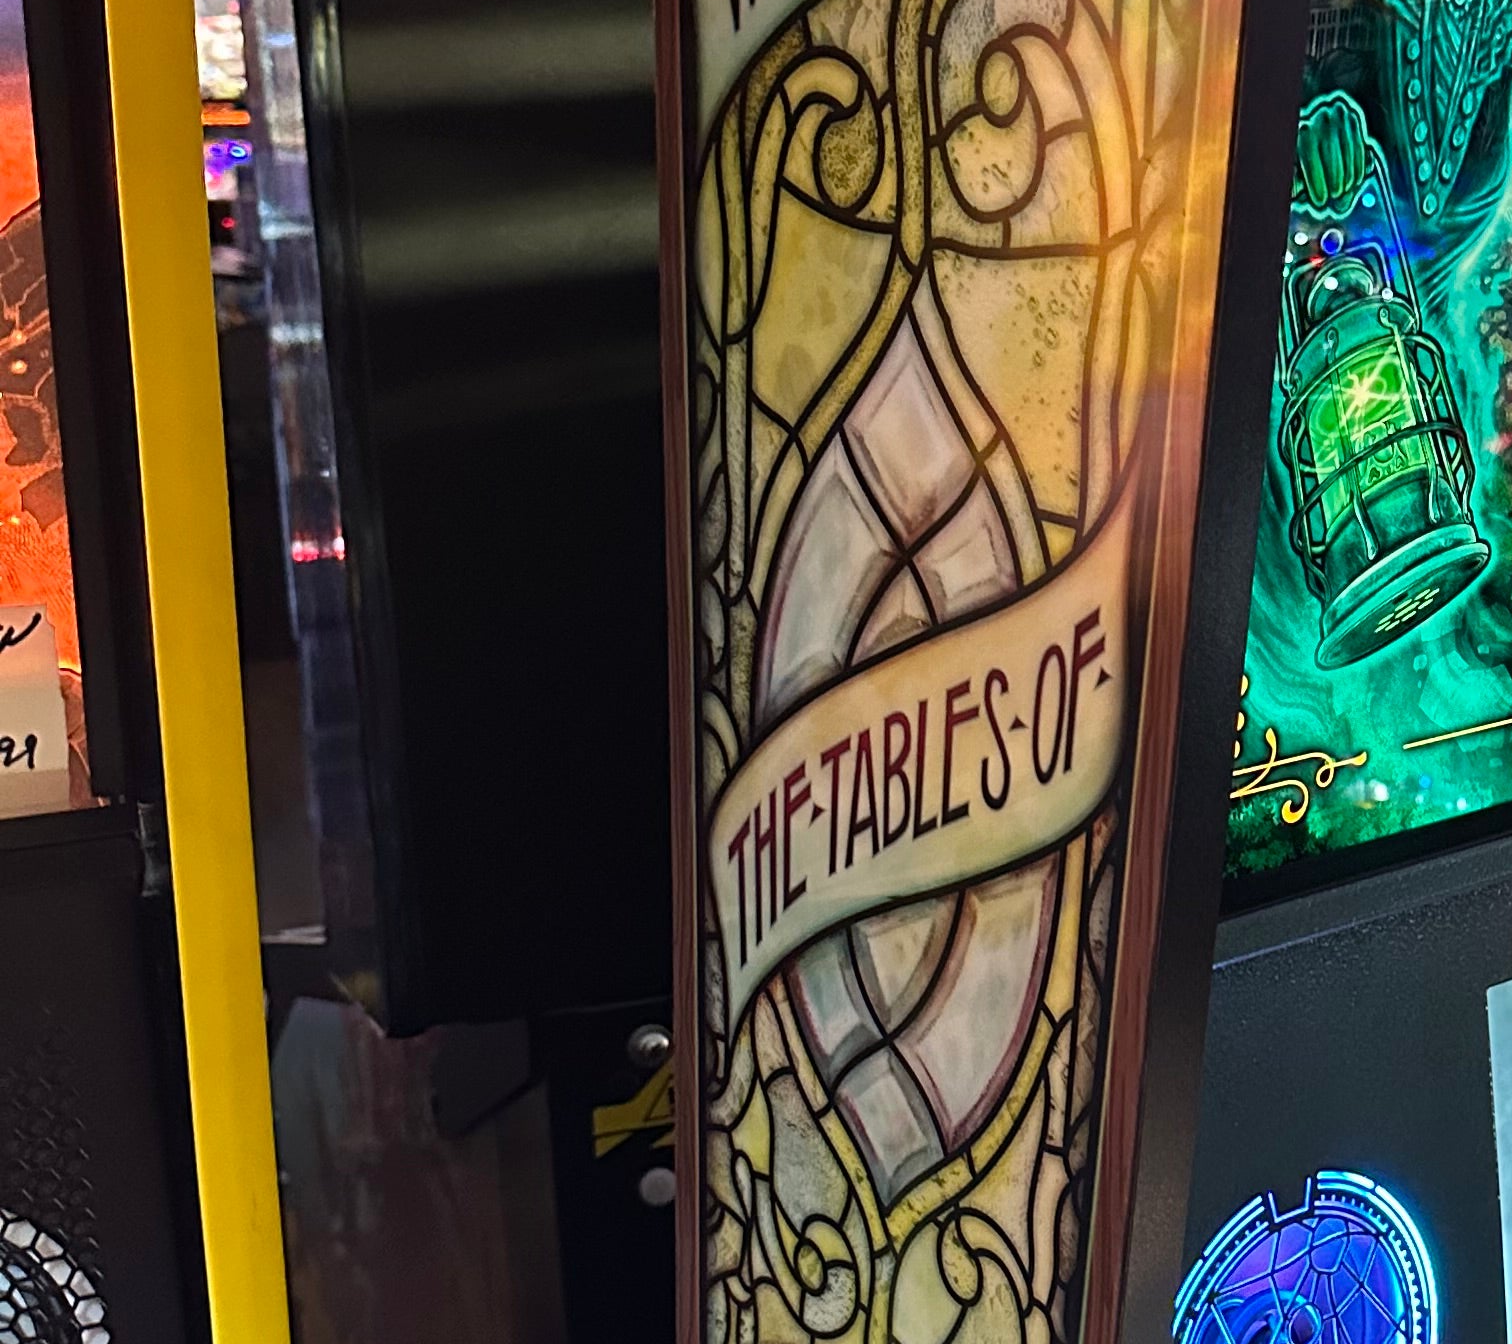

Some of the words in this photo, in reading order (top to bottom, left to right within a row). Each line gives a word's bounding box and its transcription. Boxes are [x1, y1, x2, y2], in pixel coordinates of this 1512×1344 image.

[727, 761, 810, 969] THE
[820, 668, 1010, 876] TABLES
[1032, 606, 1107, 785] OF
